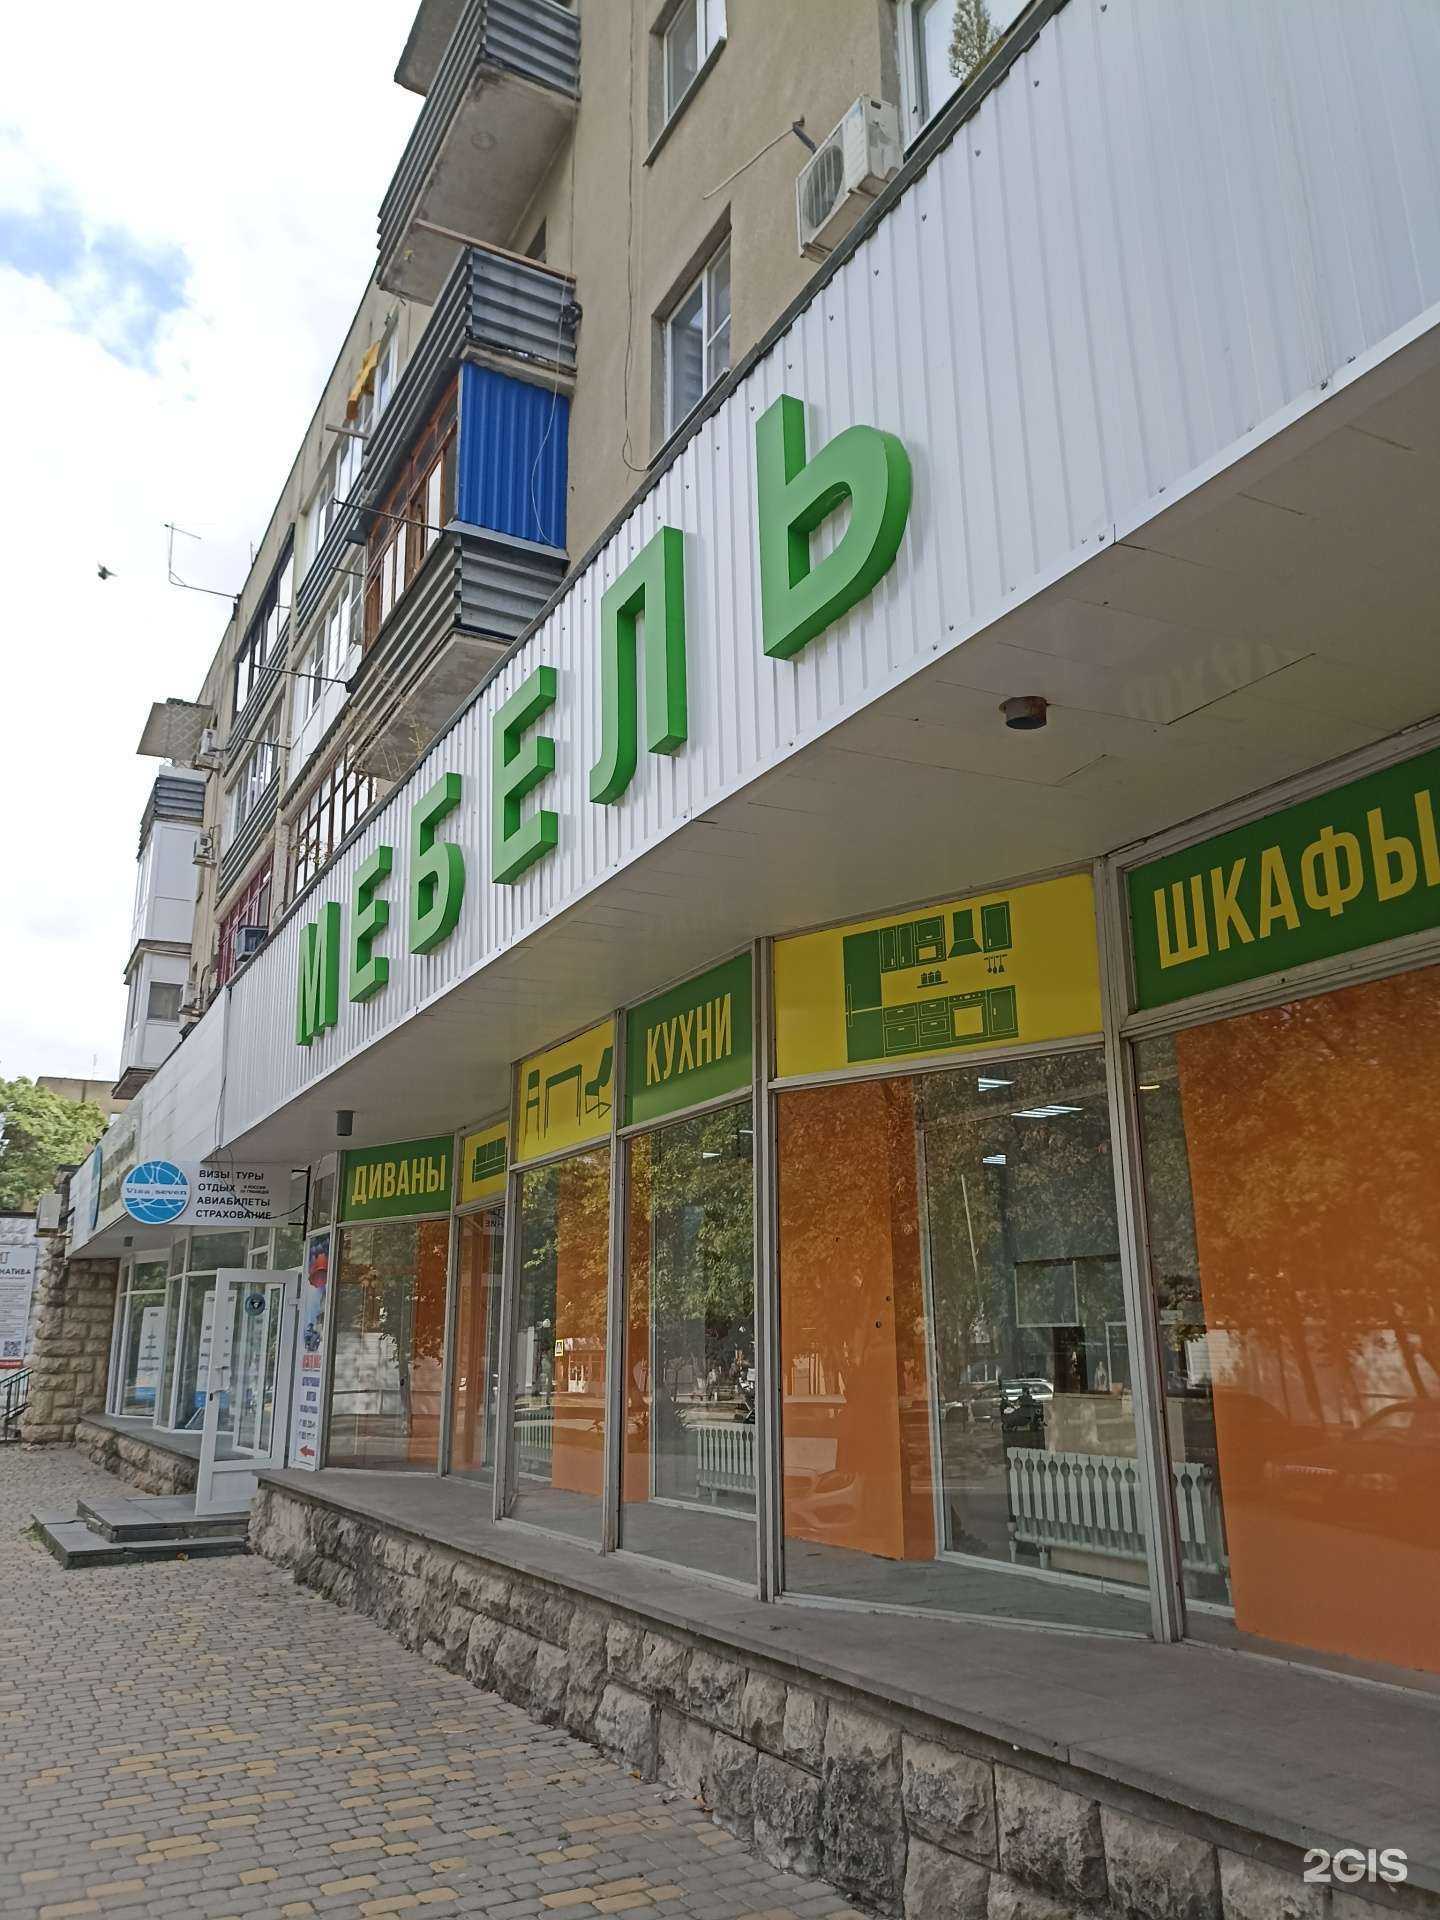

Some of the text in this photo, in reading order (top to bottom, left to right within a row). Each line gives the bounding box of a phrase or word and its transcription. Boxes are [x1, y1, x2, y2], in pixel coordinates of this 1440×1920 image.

[296, 394, 912, 1046] МЕБЕЛЬ
[1154, 789, 1440, 969] ШКАФЫ
[646, 992, 732, 1086] КУХНИ
[198, 1183, 235, 1192] ОТДЫХ
[199, 1169, 264, 1181] ВИЗЫ ТУРЫ
[351, 1154, 446, 1206] ДИВАНЫ
[195, 1209, 272, 1220] СТРАХОВАНИЕ
[197, 1196, 271, 1207] АВИАБИЛЕТЫ
